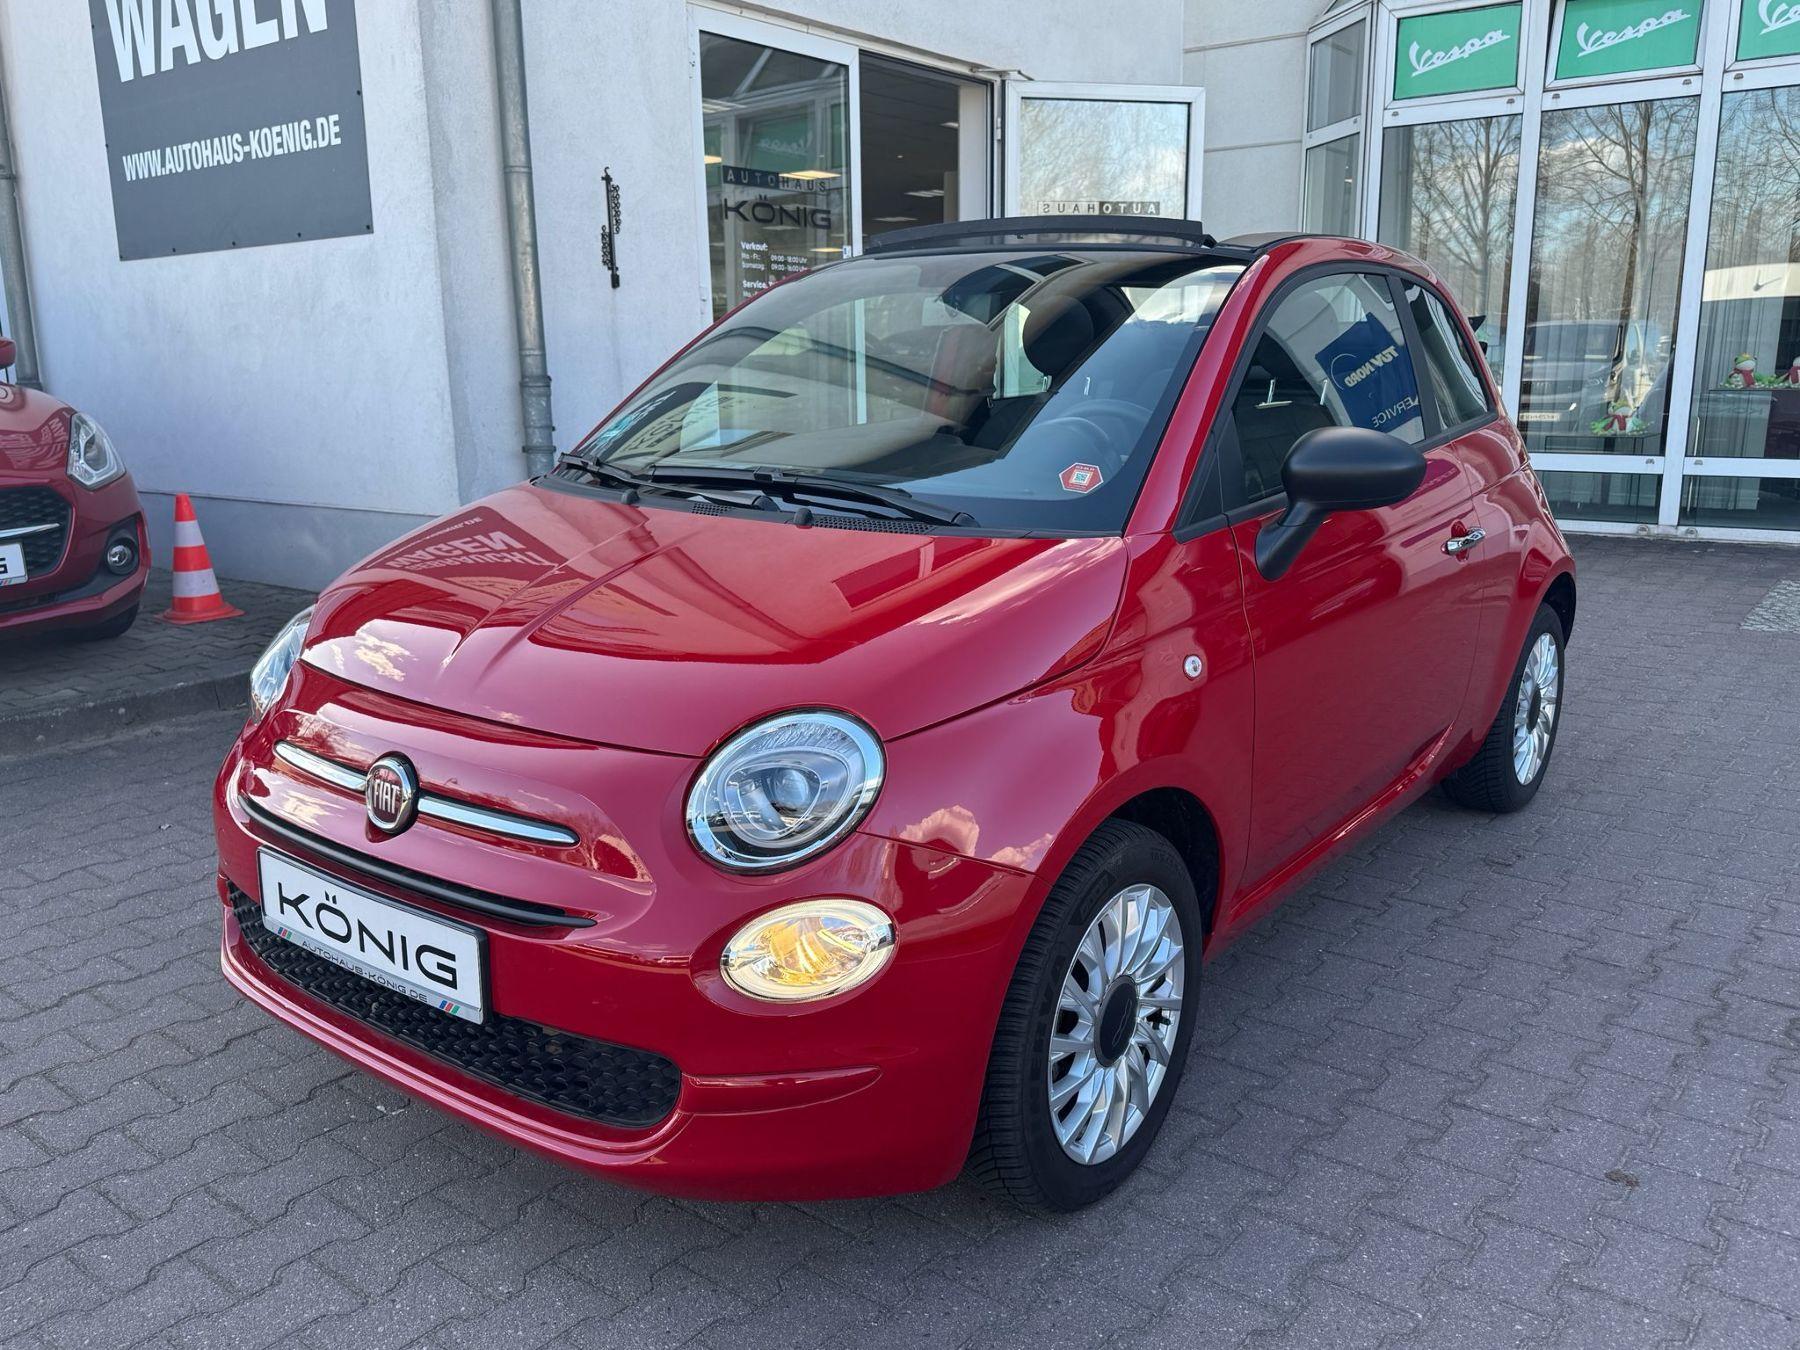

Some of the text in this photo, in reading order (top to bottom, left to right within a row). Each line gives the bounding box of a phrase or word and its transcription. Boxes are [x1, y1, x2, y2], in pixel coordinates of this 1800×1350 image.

[1409, 29, 1511, 78] Vespa
[1576, 9, 1691, 57] Vespa
[122, 114, 341, 181] WWW.AUTOHAUS-KOENIG.DE
[727, 169, 827, 193] AUTOHAUS
[723, 194, 832, 230] KÖNIG
[374, 778, 401, 814] FIAT
[278, 881, 458, 990] KÖNIG
